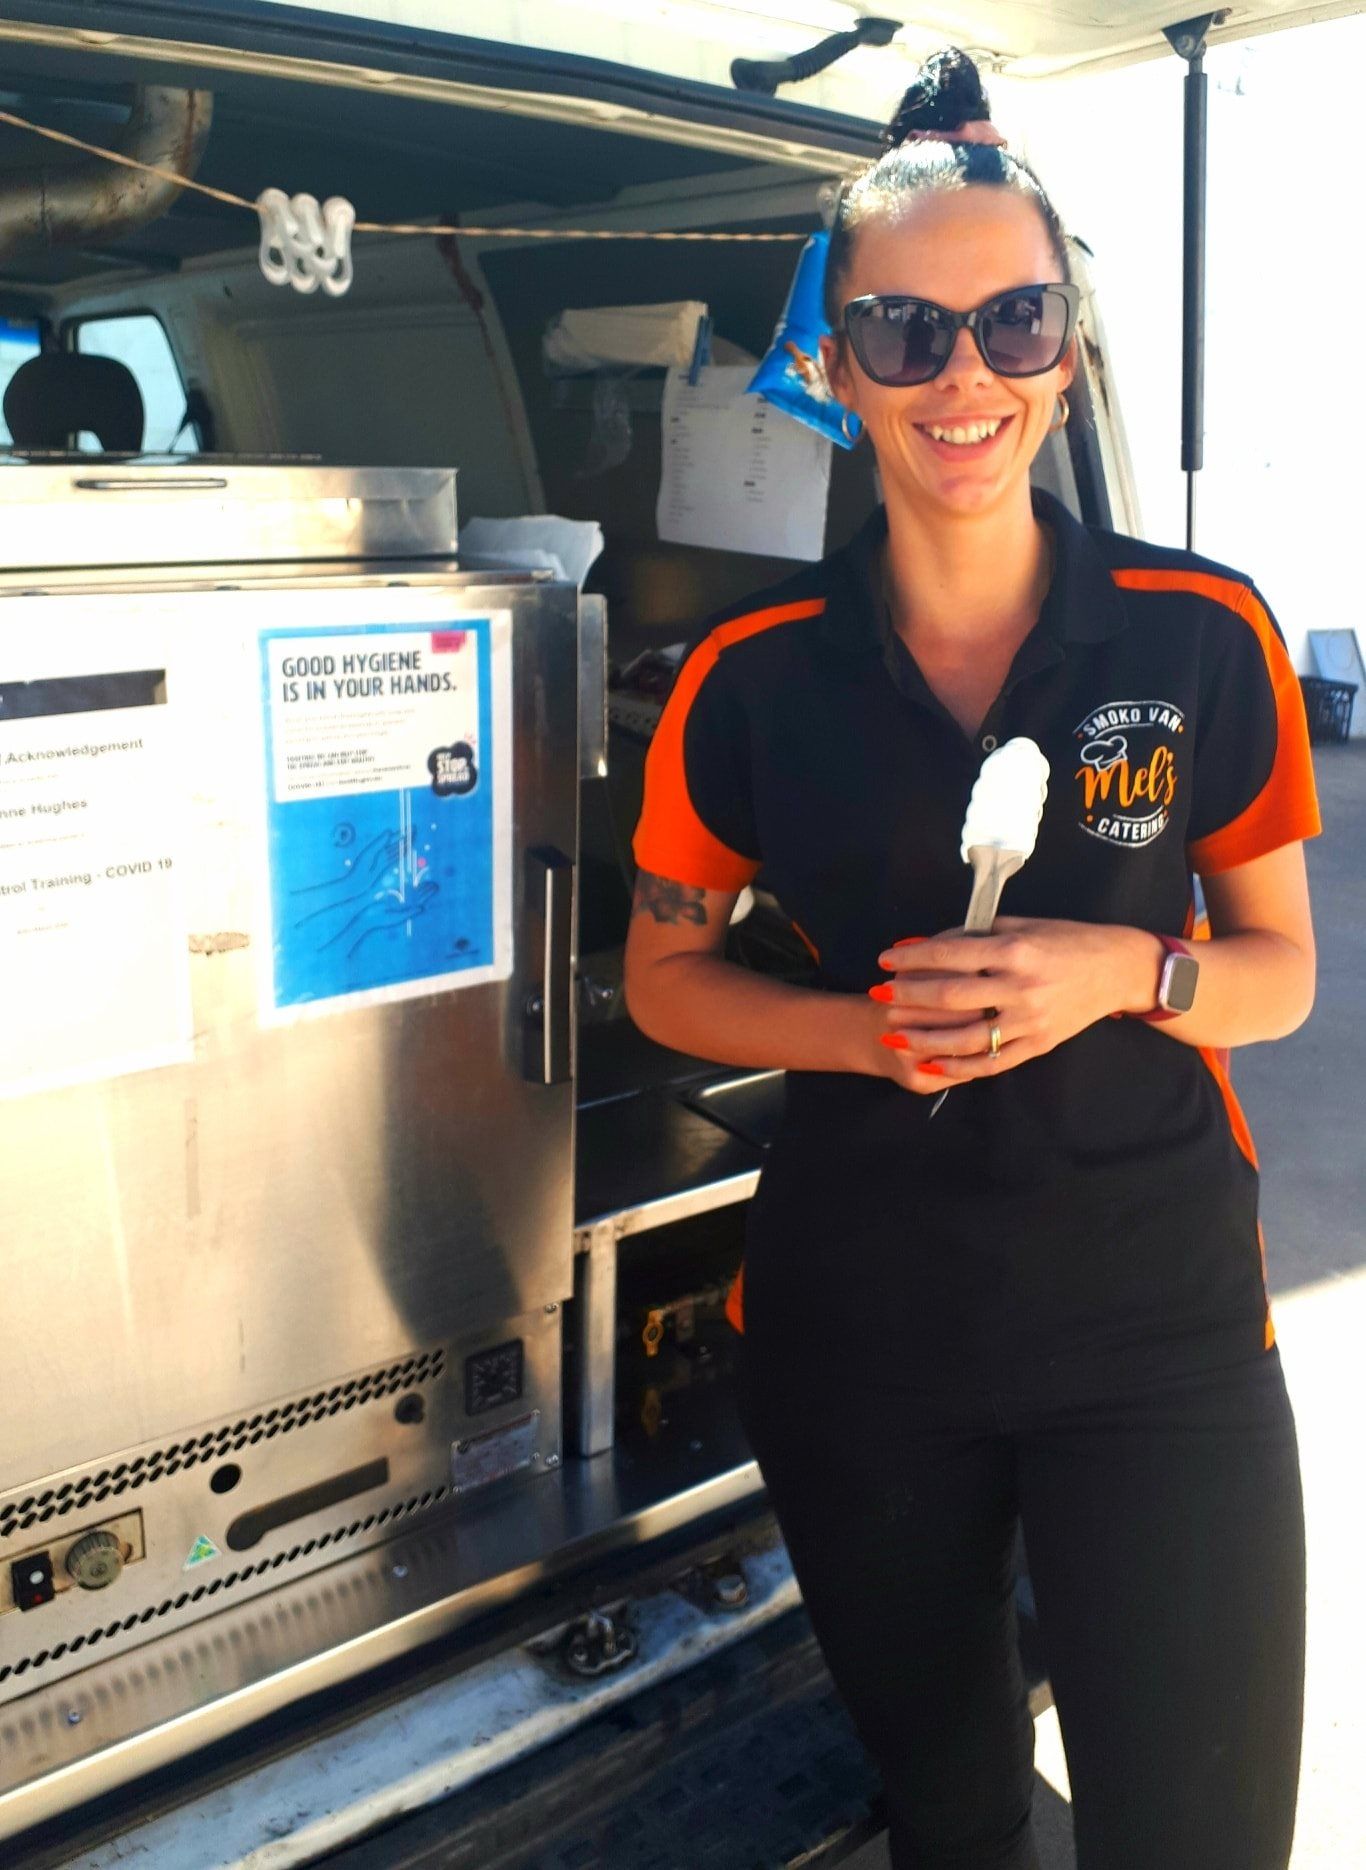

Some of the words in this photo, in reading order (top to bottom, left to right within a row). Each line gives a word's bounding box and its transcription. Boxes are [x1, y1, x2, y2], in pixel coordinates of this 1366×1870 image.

[282, 655, 336, 678] GOOD
[343, 650, 422, 675] HYGIENE
[283, 681, 299, 703] IS
[307, 680, 327, 701] IN
[334, 676, 384, 699] YOUR
[390, 672, 458, 695] HANDS.
[1082, 706, 1142, 737] SMOKO
[1148, 706, 1183, 733] VAN
[6, 738, 144, 765] Acknowledgement
[31, 798, 89, 816] Hughes
[1096, 812, 1165, 841] CATERING
[30, 871, 92, 891] Training
[105, 860, 152, 879] COVID
[157, 857, 174, 870] 19
